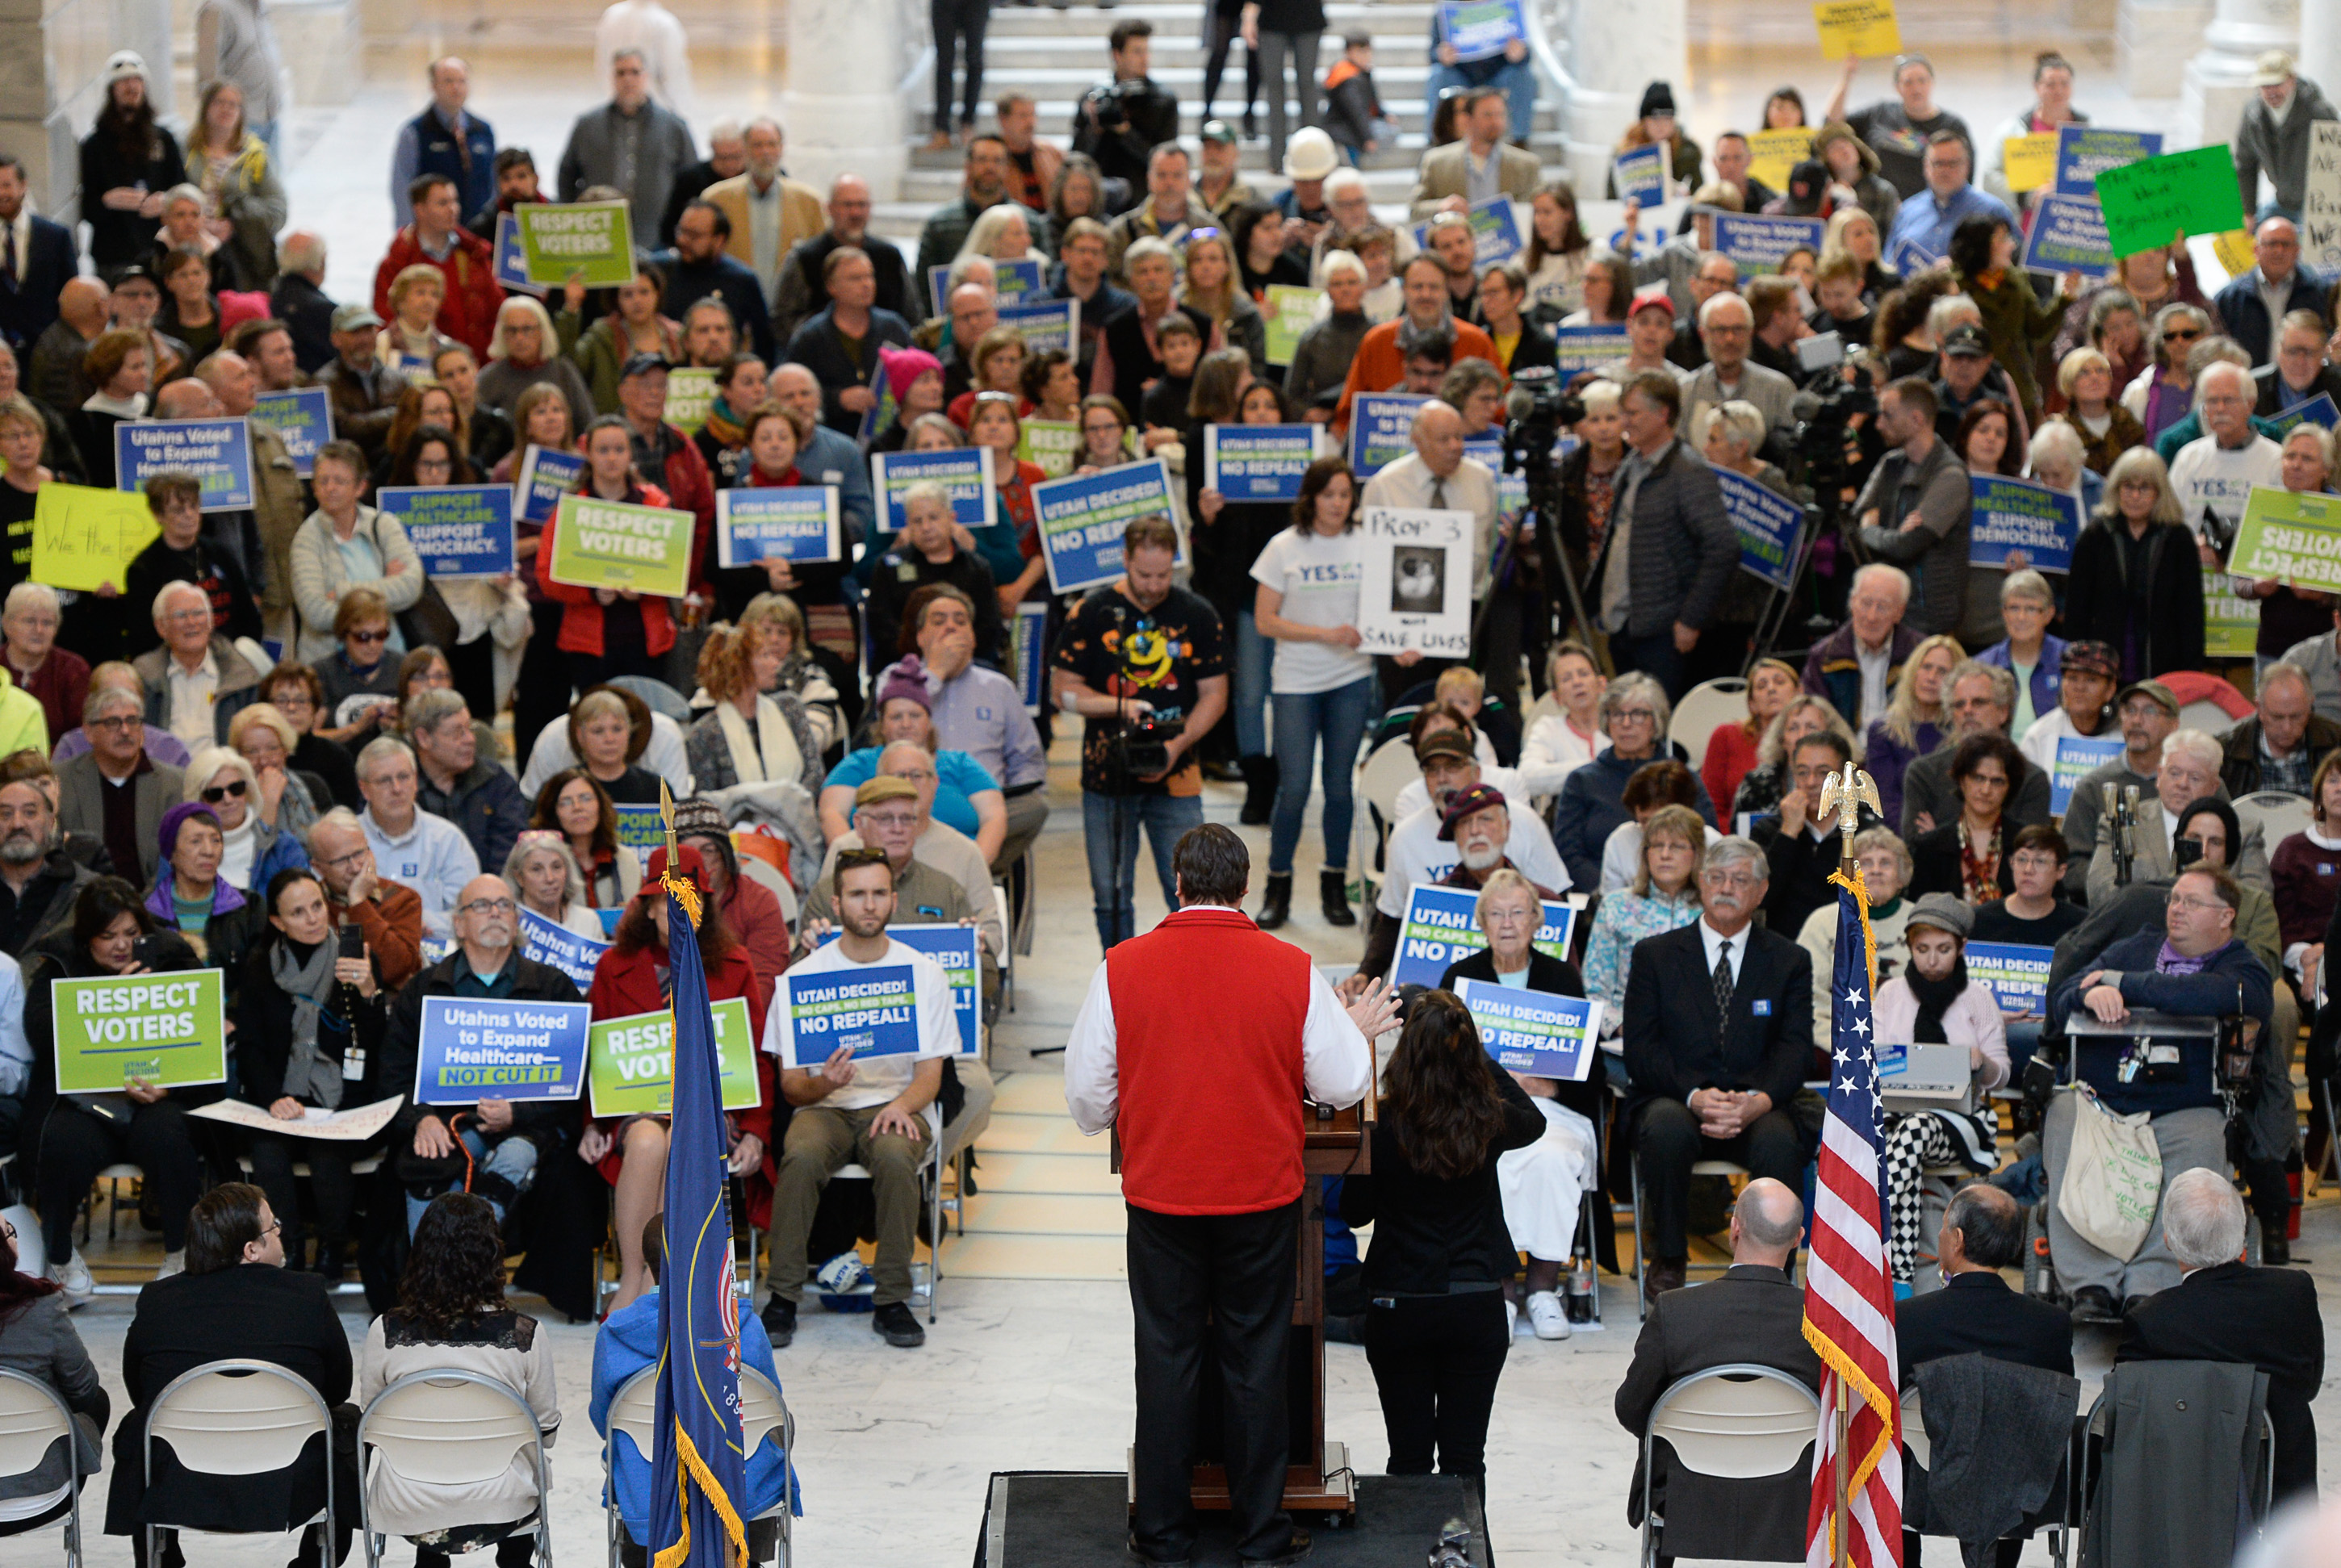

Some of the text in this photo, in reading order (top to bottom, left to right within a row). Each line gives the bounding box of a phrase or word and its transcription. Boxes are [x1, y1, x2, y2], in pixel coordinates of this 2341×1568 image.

[131, 426, 233, 446] Utahns Voted
[144, 446, 162, 462] to
[2192, 477, 2227, 496] YES
[410, 493, 483, 509] SUPPORT
[1044, 479, 1163, 520] UTAH DECIDED!
[41, 504, 75, 554] We
[410, 523, 484, 541] SUPPORT
[575, 505, 676, 539] RESPECT
[734, 525, 758, 540] NO
[1371, 512, 1430, 537] PROP
[578, 529, 668, 561] VOTERS
[1050, 529, 1084, 554] NO
[1971, 525, 2069, 551] DEMOCRACY.
[1300, 564, 1339, 582] YES
[1363, 625, 1469, 650] SAVE LIVES
[2061, 750, 2099, 766] UTAH
[1414, 907, 1468, 930] UTAH
[519, 918, 577, 959] Utahns
[1409, 926, 1432, 939] NO
[1432, 930, 1472, 945] CAPS.
[525, 942, 543, 961] to
[1406, 939, 1447, 962] NO
[1964, 955, 2052, 974] UTAH DECID
[76, 981, 201, 1014] RESPECT
[796, 980, 907, 1005] UTAH DECIDED!
[797, 1006, 813, 1016] NO
[844, 1001, 860, 1010] NO
[861, 997, 880, 1009] RED
[1472, 998, 1581, 1027] UTAH DECIDED!
[83, 1011, 195, 1043] VOTERS
[444, 1008, 569, 1030] Utahns Voted
[799, 1006, 911, 1035] NO REPEAL!
[458, 1029, 551, 1050] to Expand
[838, 1033, 861, 1043] UTAH
[1481, 1028, 1577, 1054] O REPEAL!
[124, 1060, 147, 1069] UTAH
[445, 1066, 557, 1085] NOT CUT IT
